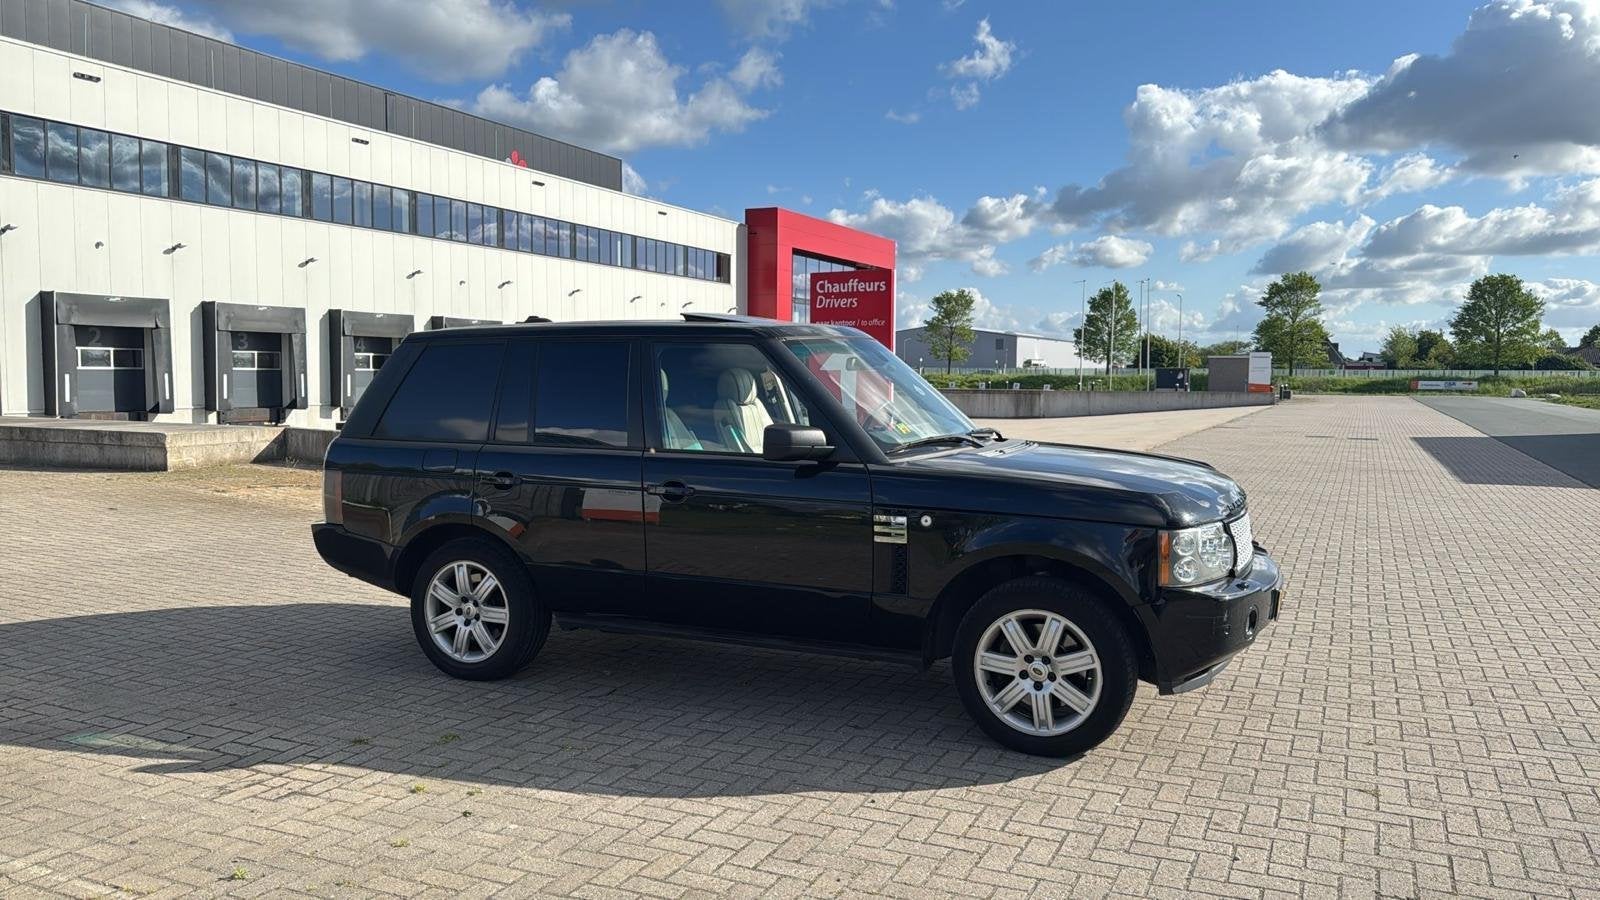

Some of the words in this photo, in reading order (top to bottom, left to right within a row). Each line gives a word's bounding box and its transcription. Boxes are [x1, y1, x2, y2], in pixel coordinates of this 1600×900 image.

[816, 279, 886, 293] Chauffeurs
[816, 295, 858, 308] Drivers
[868, 318, 886, 326] office
[88, 327, 102, 346] 2
[237, 333, 249, 350] 3
[355, 338, 366, 352] 4
